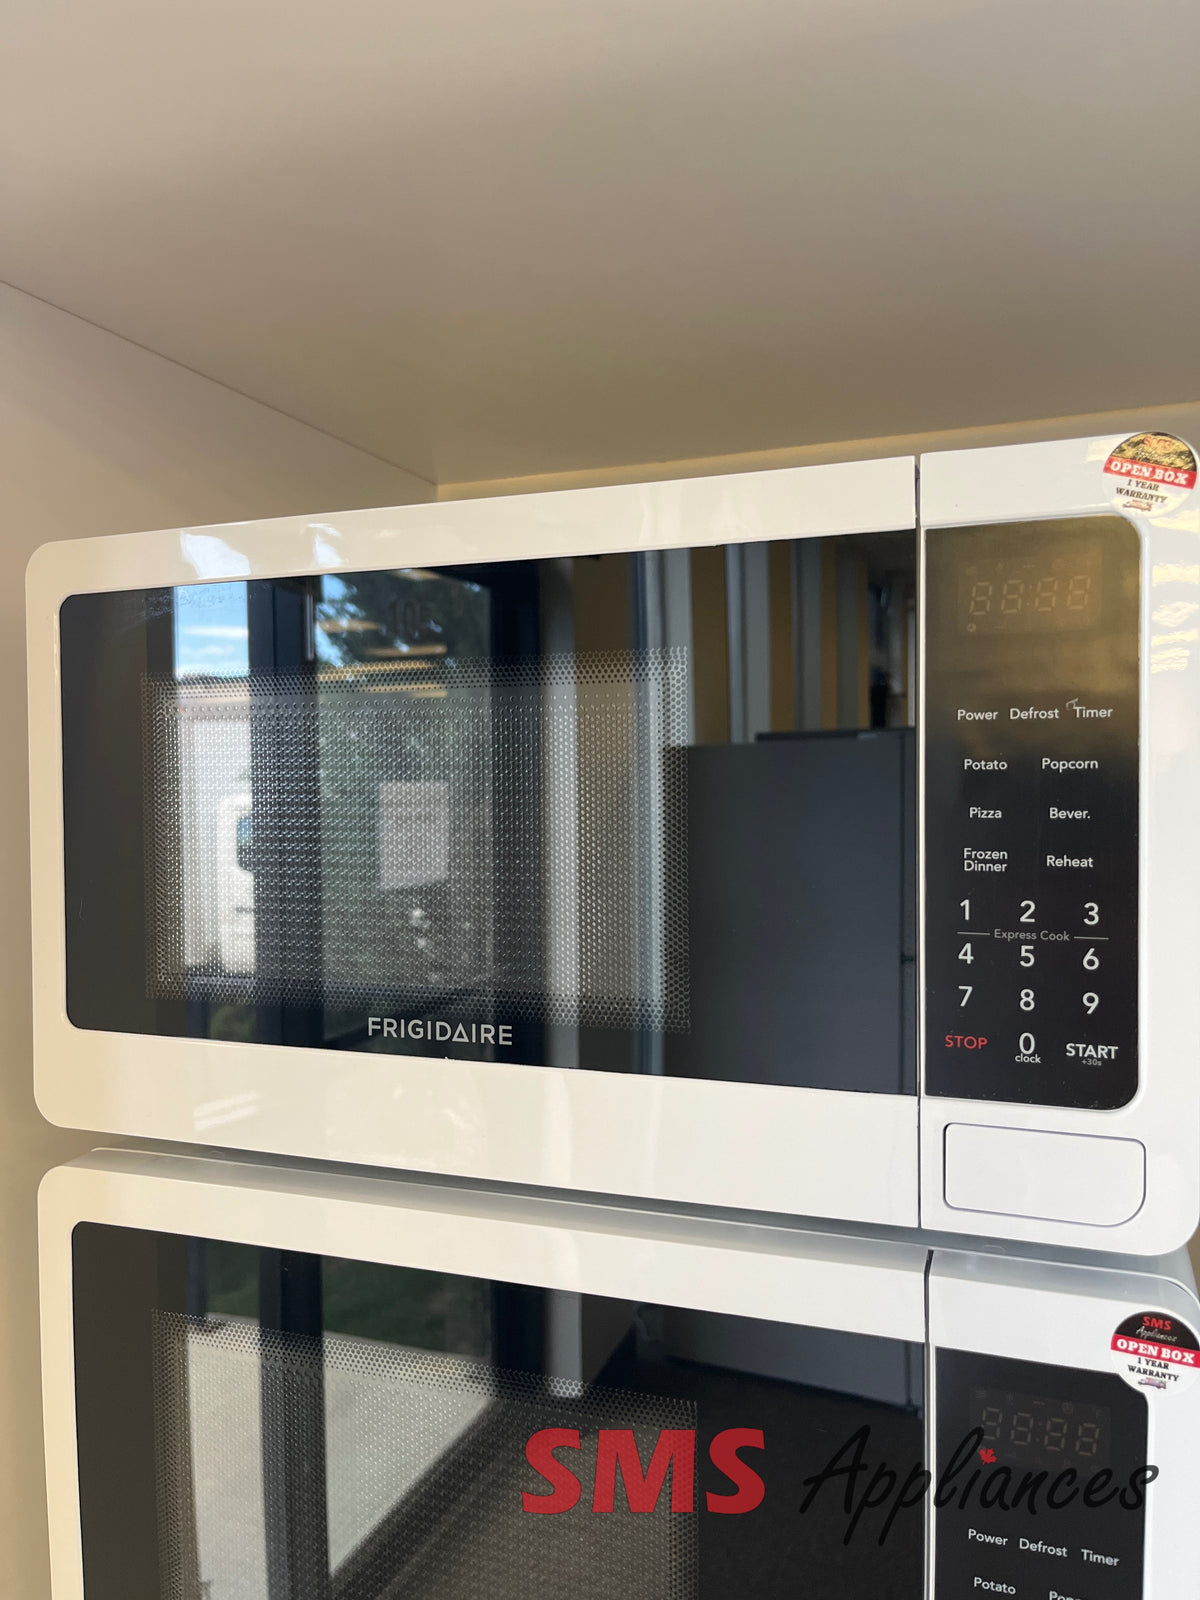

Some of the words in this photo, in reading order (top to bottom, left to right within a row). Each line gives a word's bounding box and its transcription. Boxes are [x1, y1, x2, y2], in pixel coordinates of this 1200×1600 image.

[1110, 461, 1152, 478] OPEN
[1153, 468, 1189, 485] BOX
[1135, 479, 1160, 492] YEAR
[1115, 487, 1168, 503] WARRANTY
[957, 709, 998, 720] Power
[1009, 706, 1060, 720] Defrost
[1073, 706, 1113, 718] Timer
[964, 759, 1008, 770] Potato
[1042, 758, 1098, 773] Popcorn
[969, 807, 1002, 818] Pizza
[1050, 807, 1091, 819] Bever.
[963, 847, 1008, 860] Frozen
[1046, 855, 1093, 868] Reheat
[964, 861, 1007, 872] Dinner
[959, 899, 970, 921] 1
[1019, 900, 1036, 923] 2
[1083, 902, 1099, 925] 3
[994, 929, 1037, 942] Express
[1040, 930, 1070, 941] Cook
[958, 942, 974, 964] 4
[1019, 945, 1035, 967] 5
[1082, 947, 1100, 971] 6
[958, 985, 973, 1007] 7
[1019, 988, 1035, 1011] 8
[1082, 992, 1099, 1015] 9
[368, 1017, 513, 1045] FRIGIDAIRE
[944, 1035, 988, 1049] STOP
[1019, 1032, 1035, 1055] 0
[1065, 1042, 1119, 1059] START
[1014, 1053, 1041, 1064] clock
[1142, 1316, 1172, 1331] SMS
[1136, 1325, 1178, 1342] Appliances
[1116, 1338, 1159, 1356] OPEN
[1161, 1347, 1195, 1364] BOX
[1145, 1358, 1170, 1370] YEAR
[1127, 1364, 1179, 1382] WARRANTY
[968, 1528, 1008, 1546] Power
[1019, 1538, 1068, 1557] Defrost
[1081, 1549, 1120, 1567] Timer
[973, 1576, 1016, 1595] Potato
